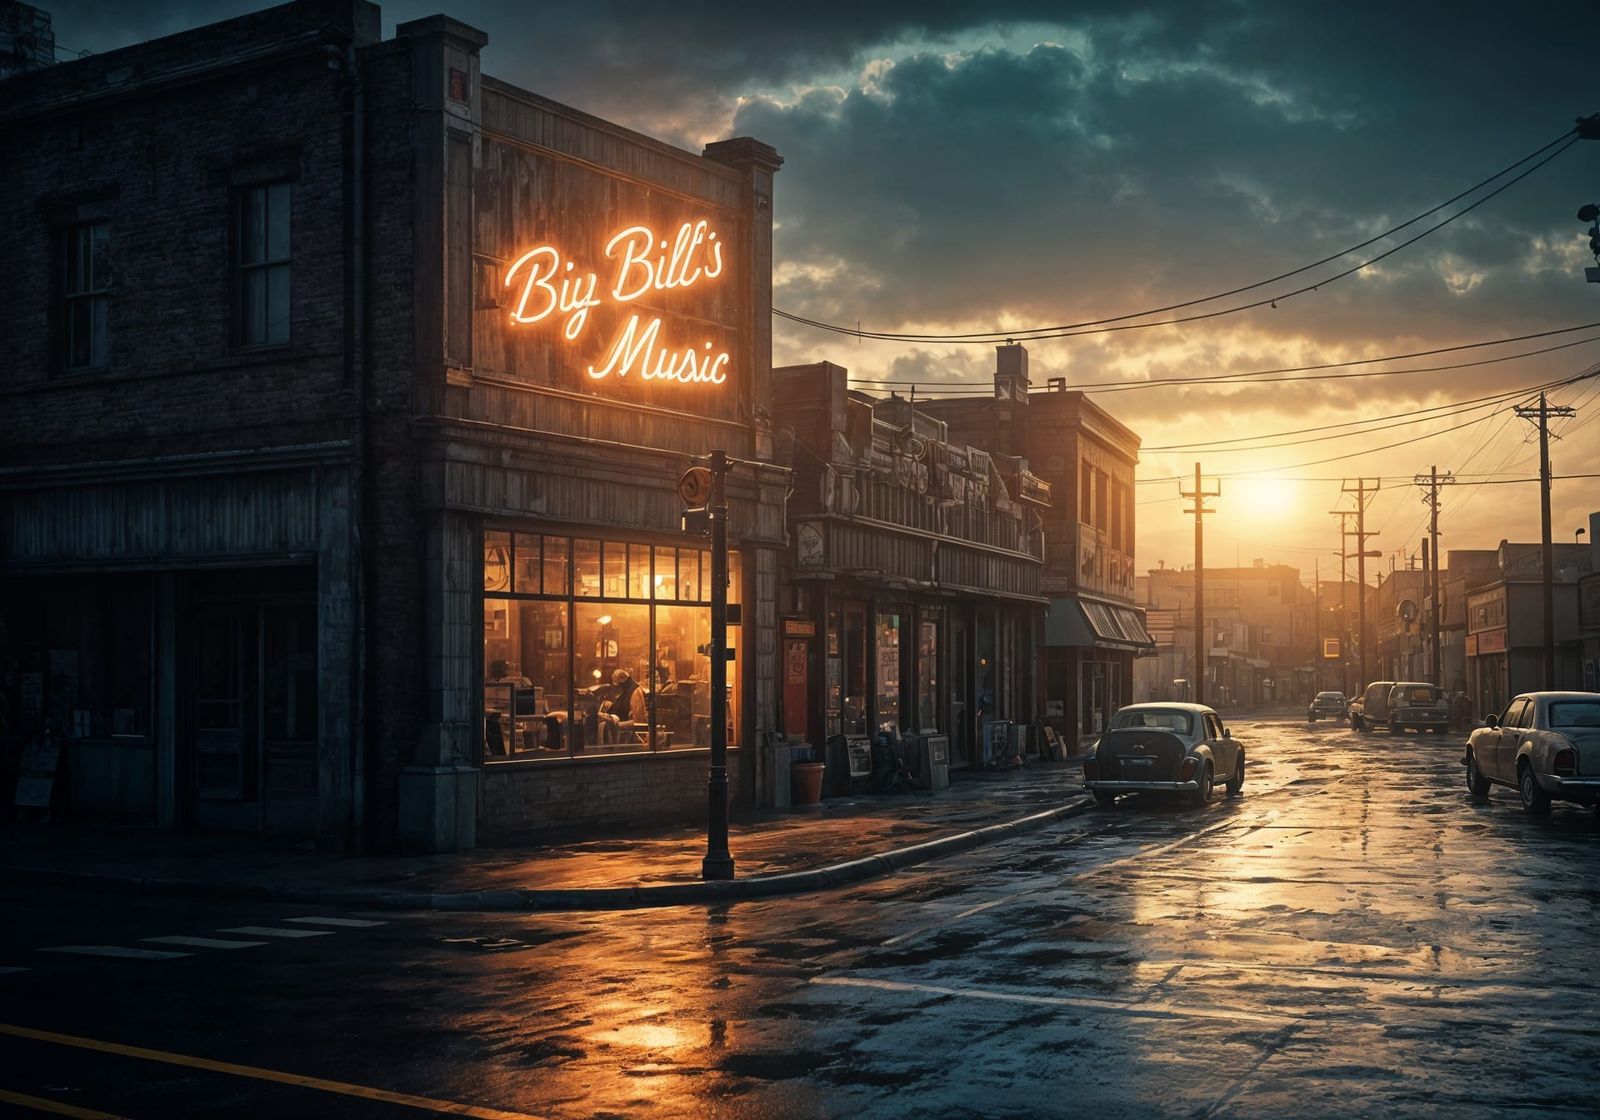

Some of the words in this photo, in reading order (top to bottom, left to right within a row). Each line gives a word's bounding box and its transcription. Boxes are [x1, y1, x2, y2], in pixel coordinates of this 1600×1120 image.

[505, 247, 600, 340] Big
[605, 220, 722, 302] Bill's
[588, 315, 730, 385] Music
